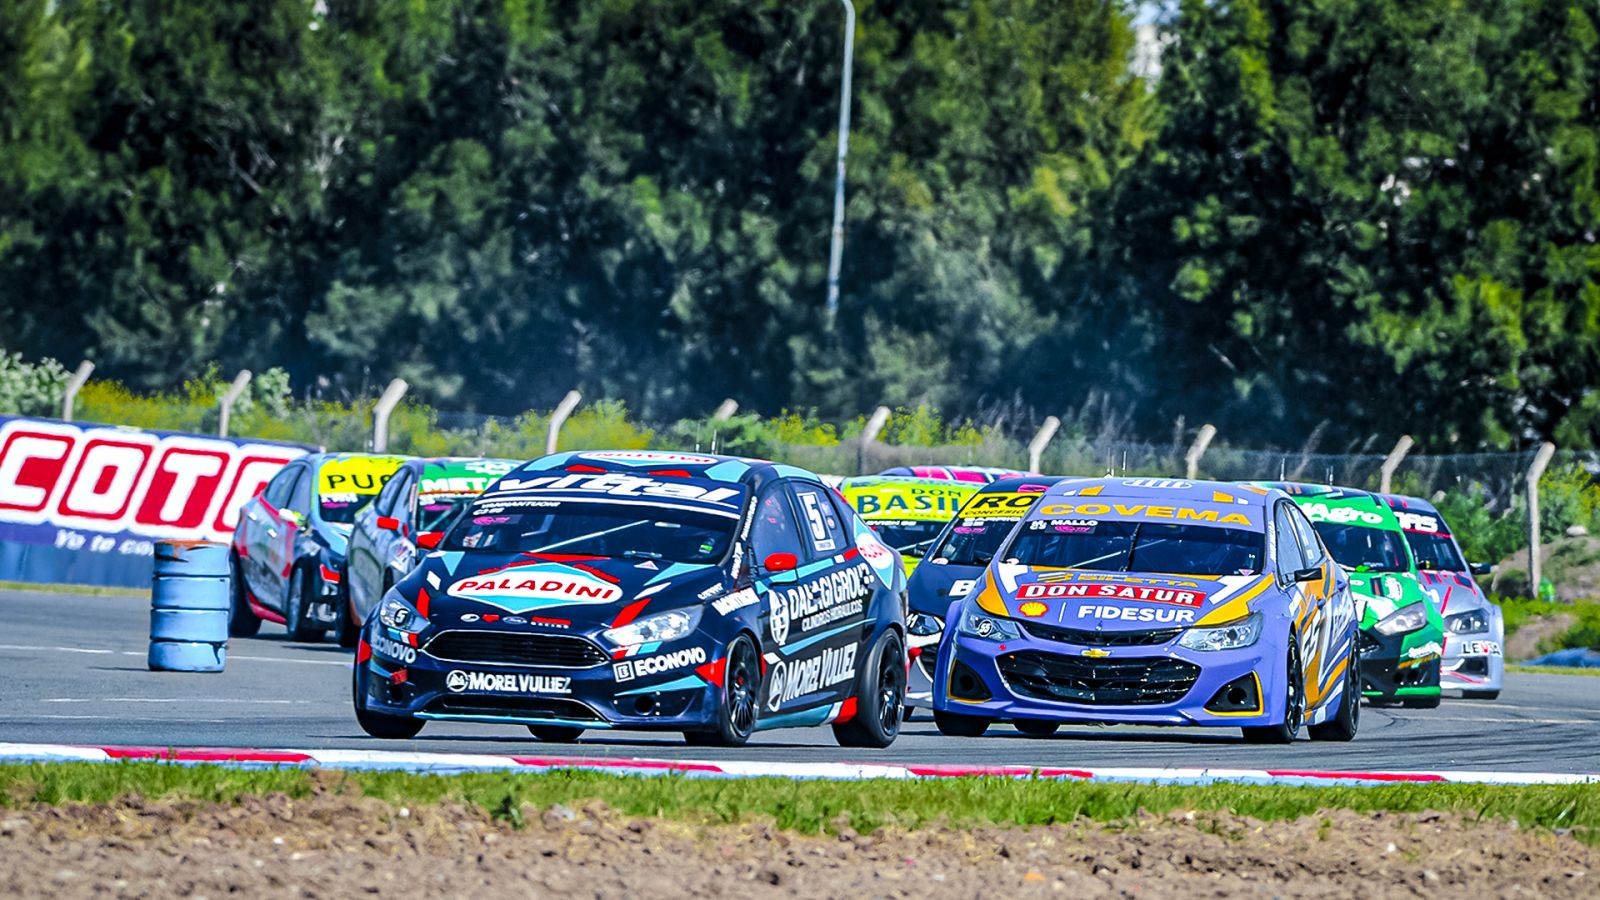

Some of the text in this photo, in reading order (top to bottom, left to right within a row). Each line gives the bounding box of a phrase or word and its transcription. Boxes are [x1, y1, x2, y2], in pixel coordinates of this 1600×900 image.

[911, 487, 962, 498] DON
[803, 495, 826, 540] 5
[1040, 503, 1252, 526] COVEMA
[1051, 519, 1099, 527] MALLO
[54, 528, 87, 551] Yo
[456, 578, 614, 600] PALADINI
[1026, 585, 1196, 605] DON SATUR
[1077, 605, 1195, 623] FIDESUR
[634, 646, 707, 677] ECONOVO
